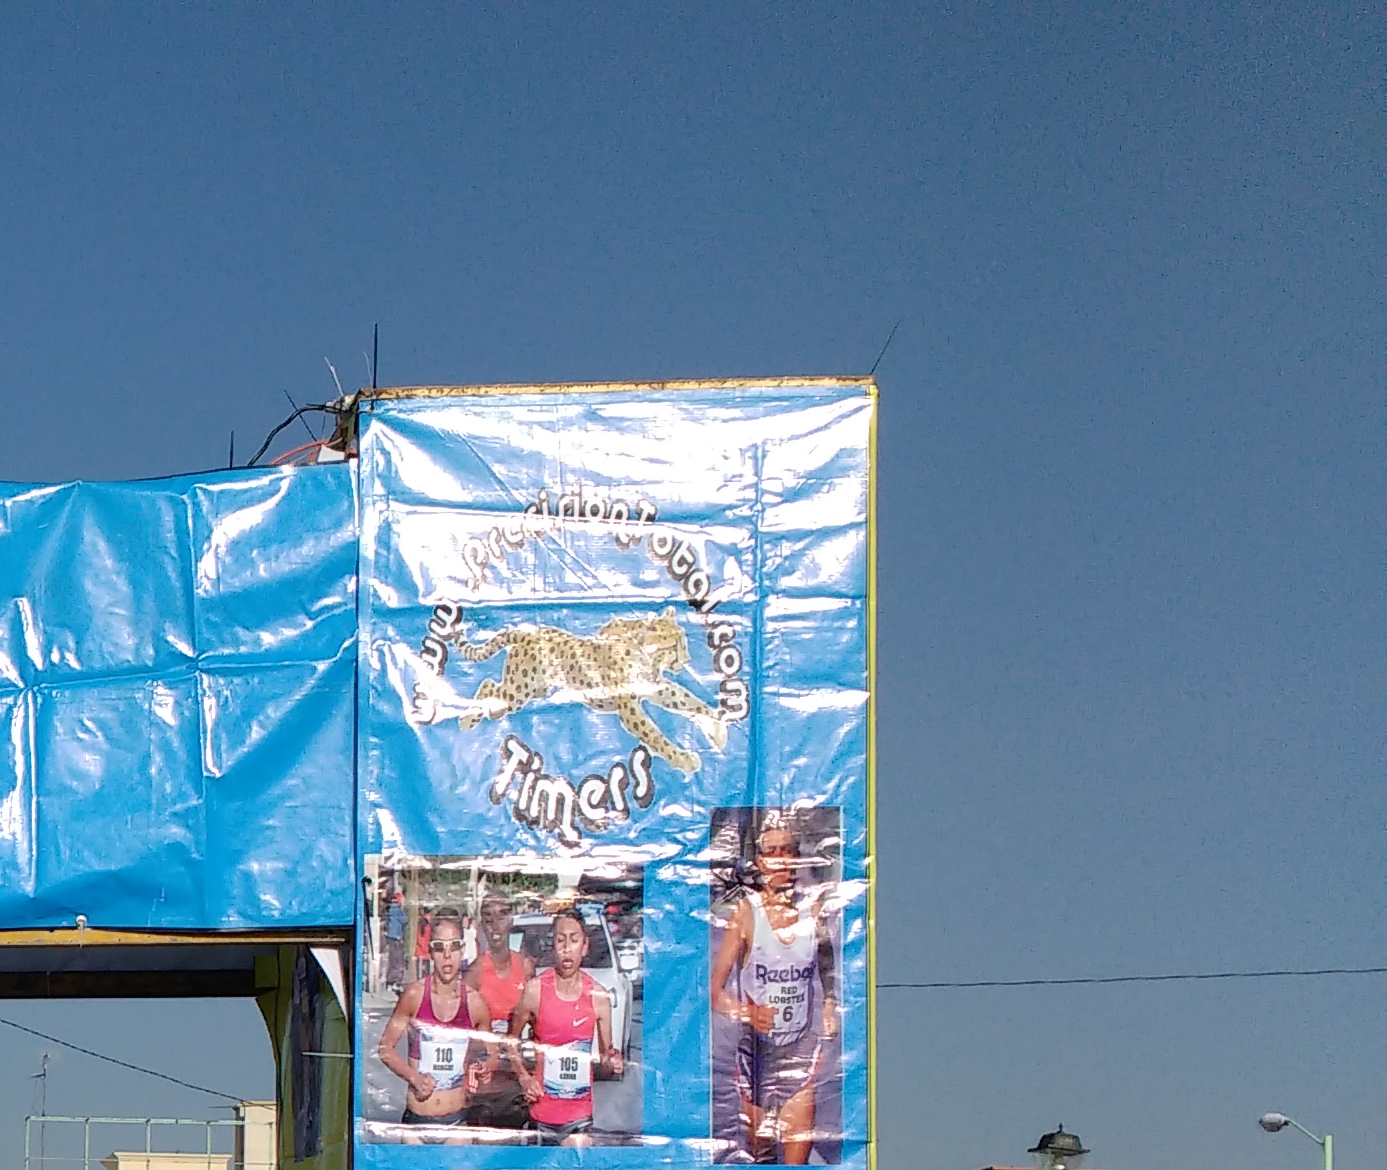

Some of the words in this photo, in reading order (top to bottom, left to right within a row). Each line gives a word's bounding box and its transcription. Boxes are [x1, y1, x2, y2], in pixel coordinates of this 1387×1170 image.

[780, 986, 798, 995] RED
[782, 1005, 794, 1023] 6
[434, 1047, 454, 1063] 110
[558, 1056, 579, 1072] 105
